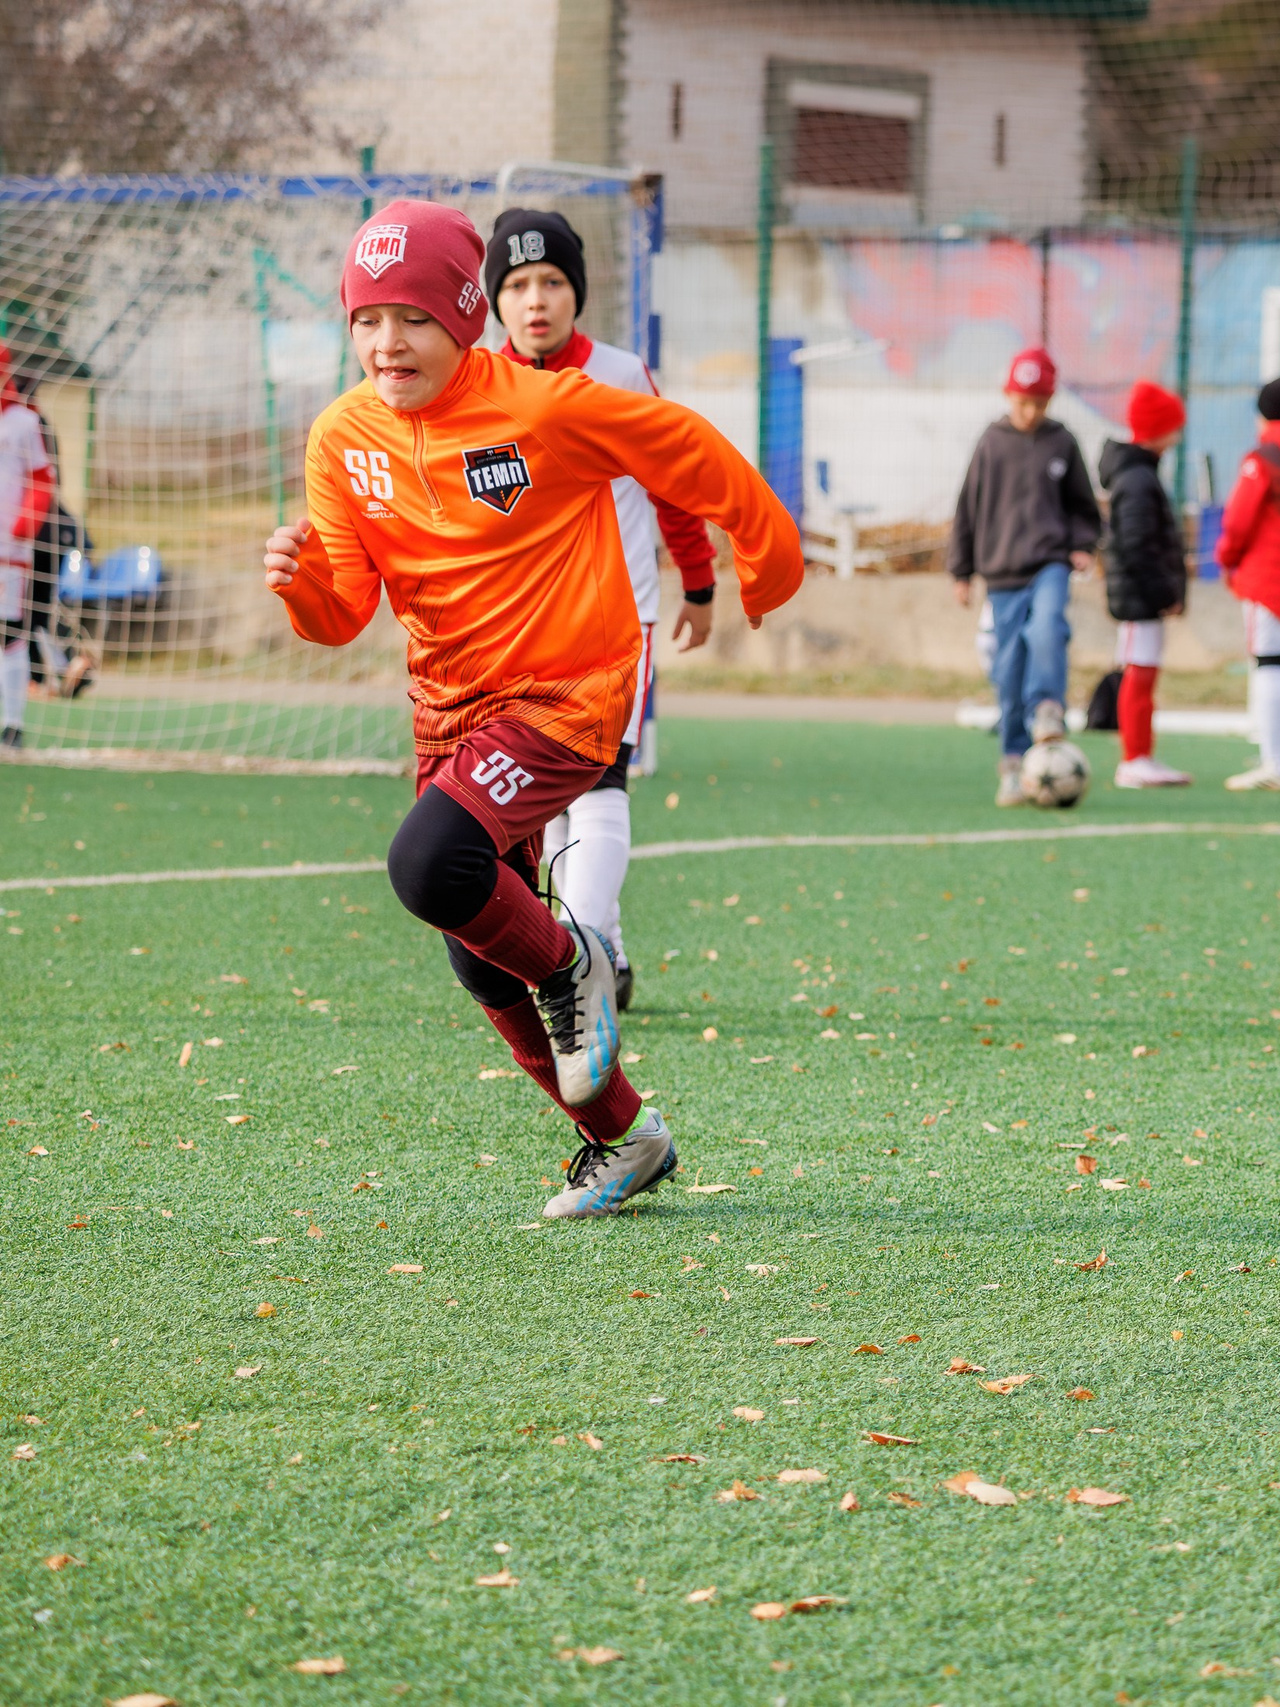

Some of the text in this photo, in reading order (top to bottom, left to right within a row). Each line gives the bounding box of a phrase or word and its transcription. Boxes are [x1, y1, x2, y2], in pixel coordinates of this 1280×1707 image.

[361, 236, 401, 259] ТЕМП
[507, 230, 546, 267] 18
[470, 461, 525, 493] ТЕМП
